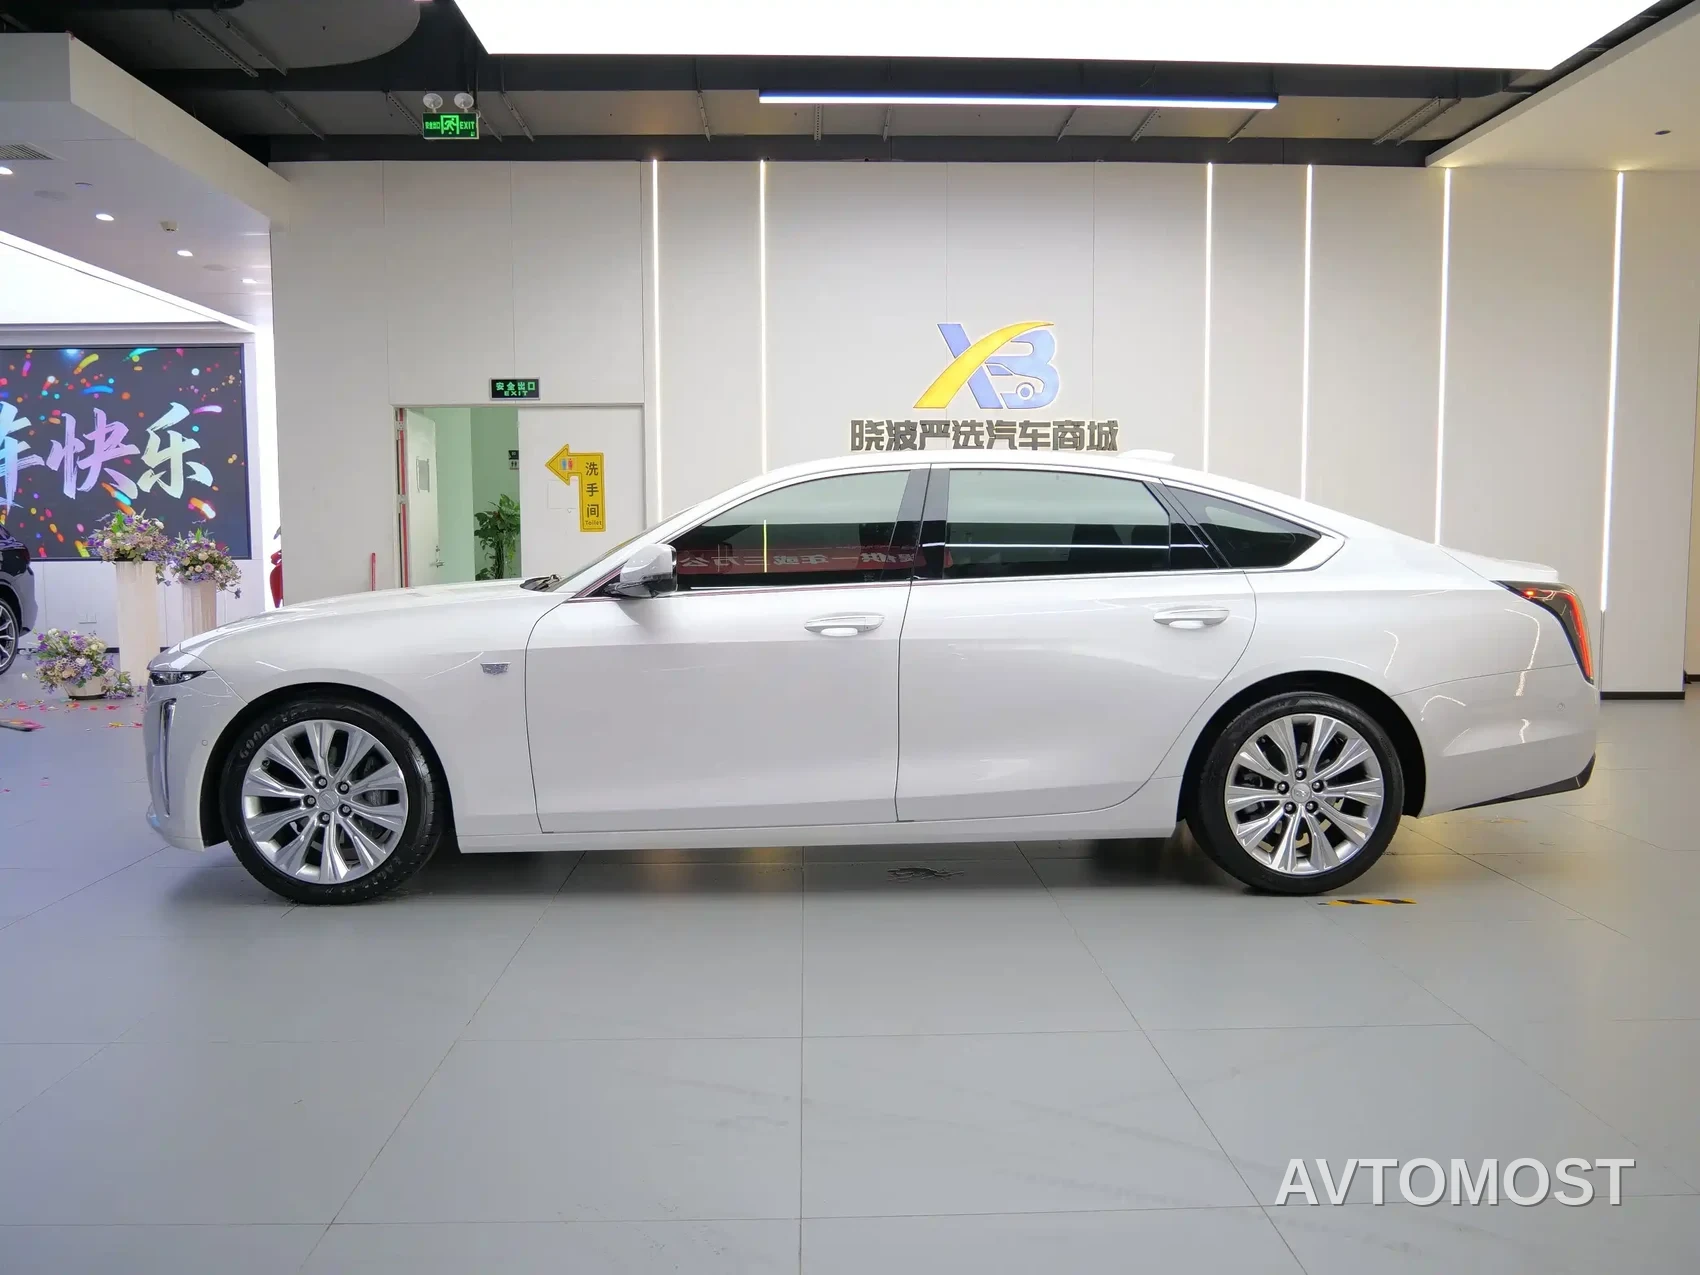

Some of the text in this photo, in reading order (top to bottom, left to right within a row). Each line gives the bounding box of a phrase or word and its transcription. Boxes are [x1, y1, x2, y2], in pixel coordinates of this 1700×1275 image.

[460, 121, 475, 130] EXIT
[495, 381, 536, 391] 安全出口
[850, 419, 1119, 452] 晓波严选汽车商城
[585, 462, 600, 518] 洗手间
